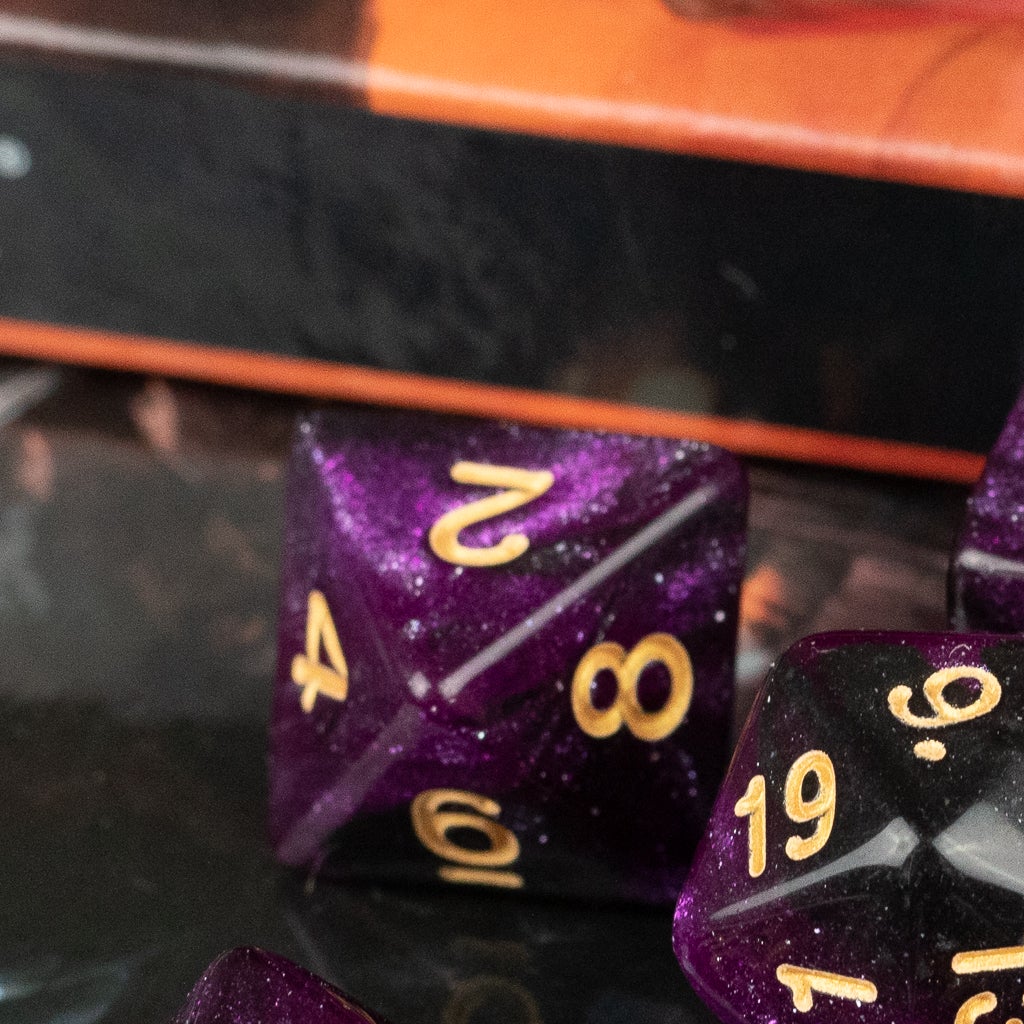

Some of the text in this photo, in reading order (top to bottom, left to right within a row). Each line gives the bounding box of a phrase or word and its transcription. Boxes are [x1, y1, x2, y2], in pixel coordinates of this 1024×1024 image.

[429, 461, 554, 566] 2
[291, 590, 348, 713] 4
[571, 632, 694, 742] 8
[735, 750, 836, 878] 19
[776, 963, 878, 1013] 1
